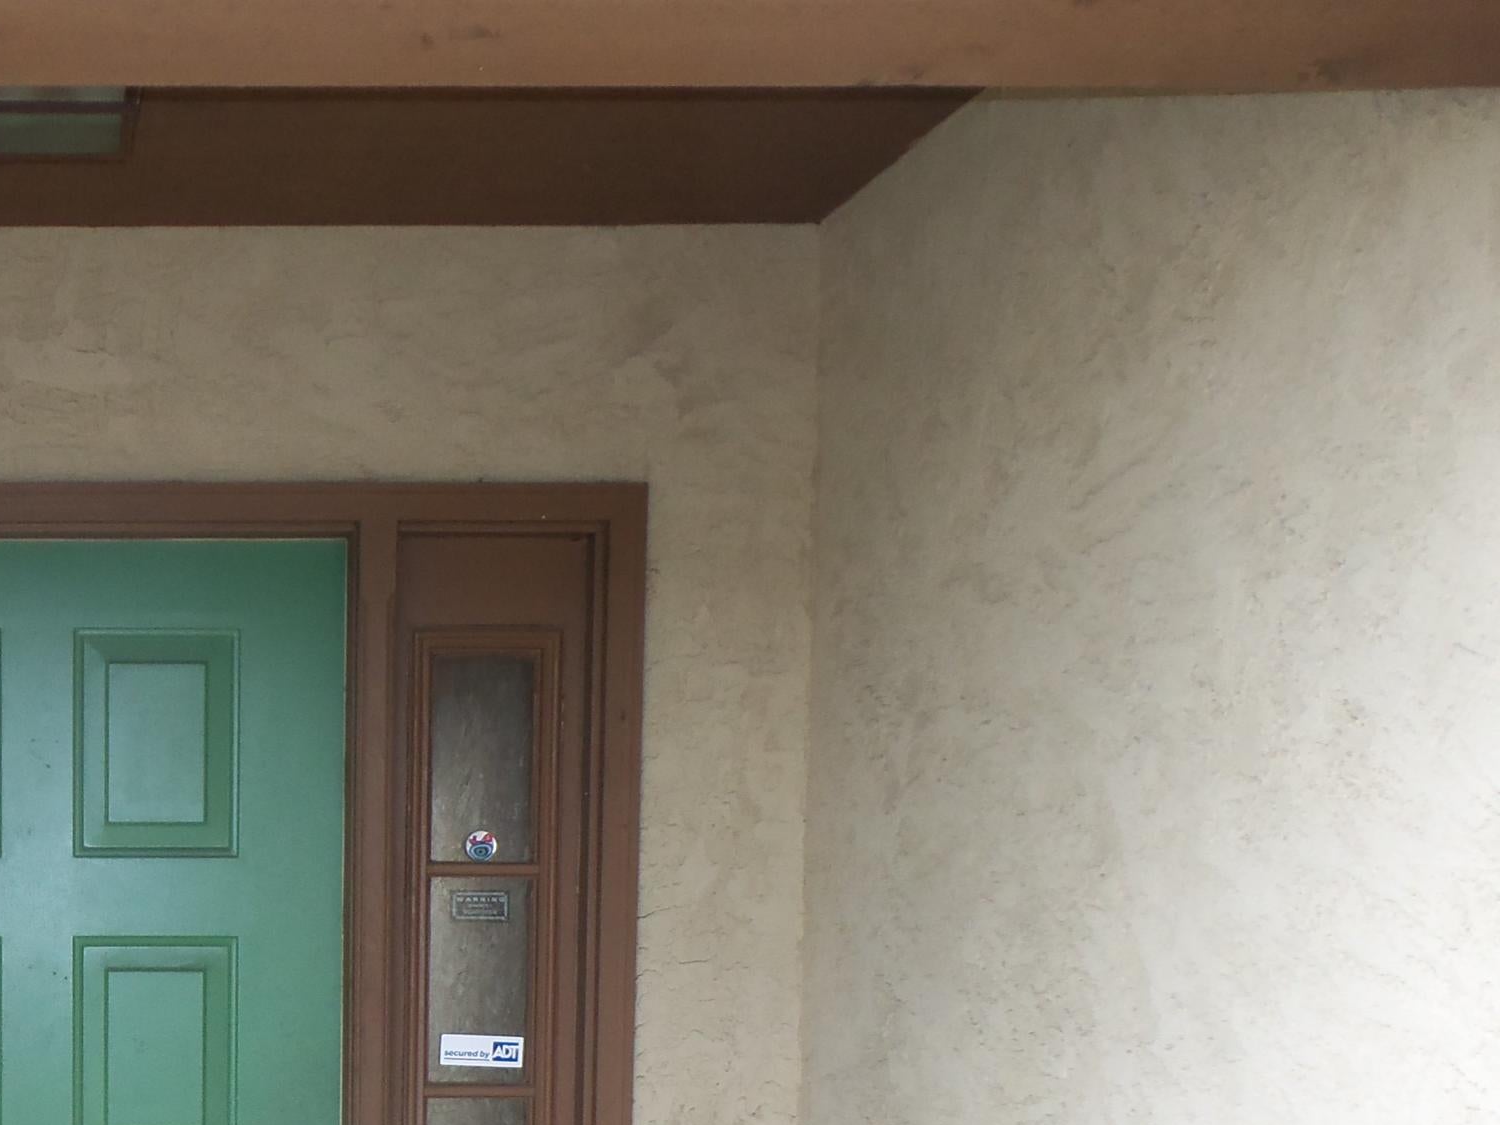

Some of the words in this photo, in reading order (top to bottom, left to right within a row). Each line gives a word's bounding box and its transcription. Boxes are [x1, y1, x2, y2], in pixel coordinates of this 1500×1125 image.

[444, 1049, 478, 1057] secured
[480, 1050, 490, 1058] by
[492, 1044, 518, 1060] ADT
